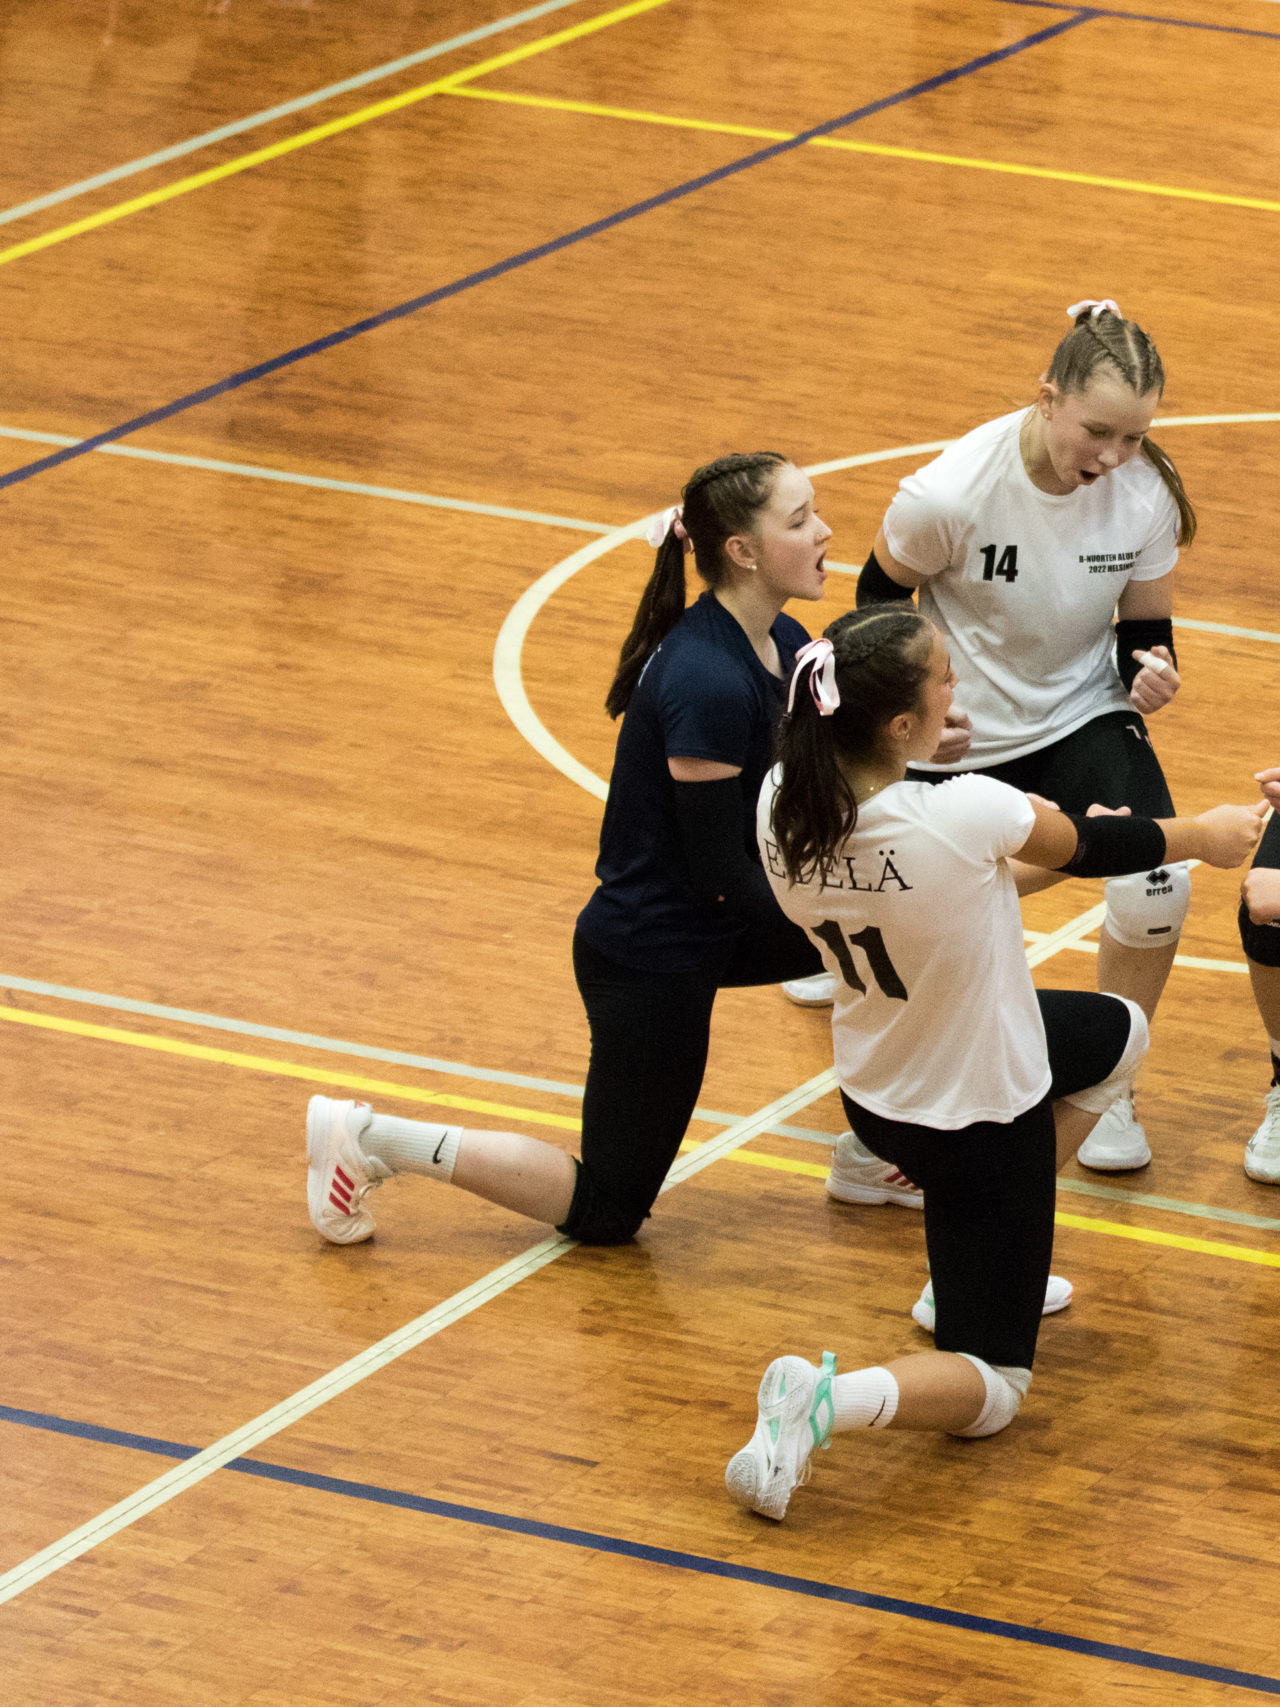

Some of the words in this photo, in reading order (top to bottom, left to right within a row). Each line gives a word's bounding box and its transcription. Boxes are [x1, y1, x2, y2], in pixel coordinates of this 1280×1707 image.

[980, 544, 1018, 583] 14
[1079, 554, 1116, 563] B-NUORTEN
[1118, 552, 1134, 561] ALUE
[1088, 564, 1106, 573] 2022
[810, 919, 908, 1001] 11
